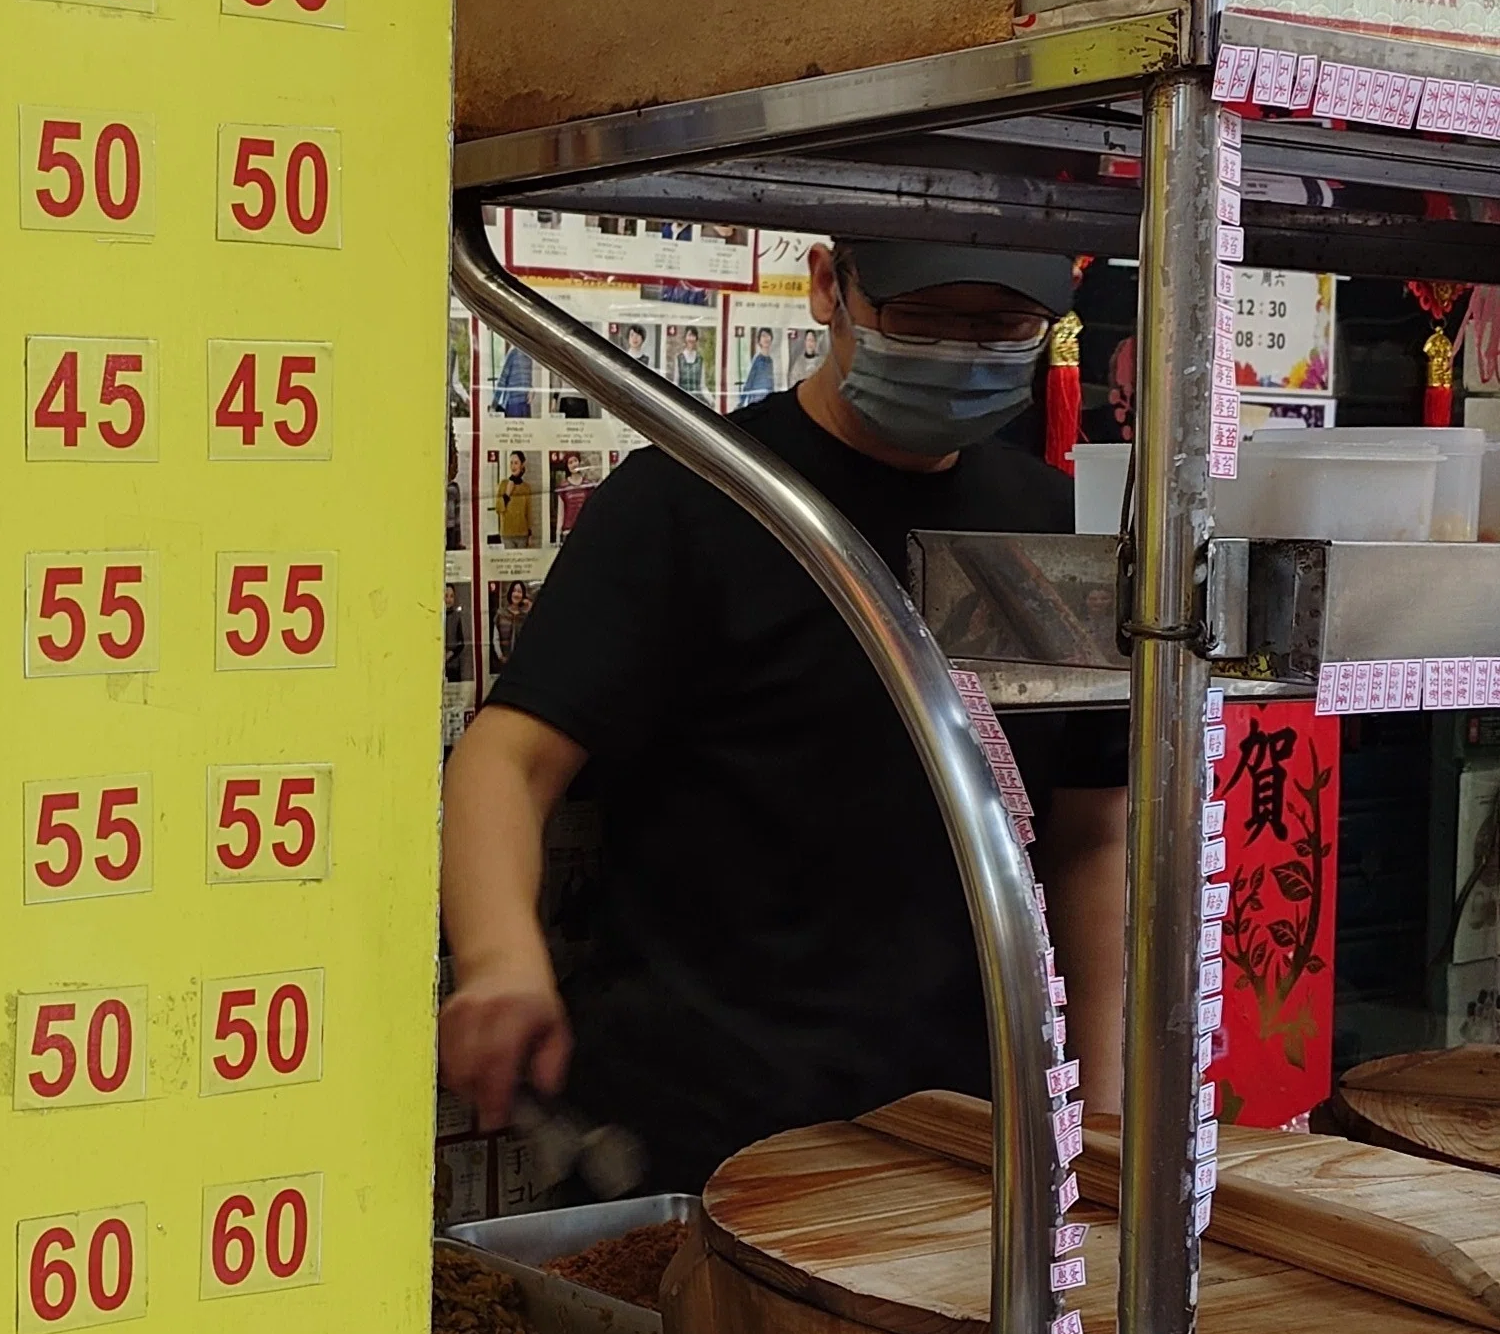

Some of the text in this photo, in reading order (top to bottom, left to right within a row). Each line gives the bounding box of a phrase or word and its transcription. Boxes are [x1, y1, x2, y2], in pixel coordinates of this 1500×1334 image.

[37, 120, 141, 220] 50
[232, 137, 329, 235] 50
[34, 352, 145, 449] 45
[215, 354, 318, 447] 45
[38, 566, 145, 662] 55
[226, 564, 324, 657] 55
[35, 787, 141, 887] 55
[217, 778, 315, 870] 55
[1223, 719, 1297, 847] 賀
[28, 999, 132, 1097] 50
[214, 983, 309, 1080] 50
[29, 1219, 133, 1321] 60
[212, 1188, 308, 1285] 60
